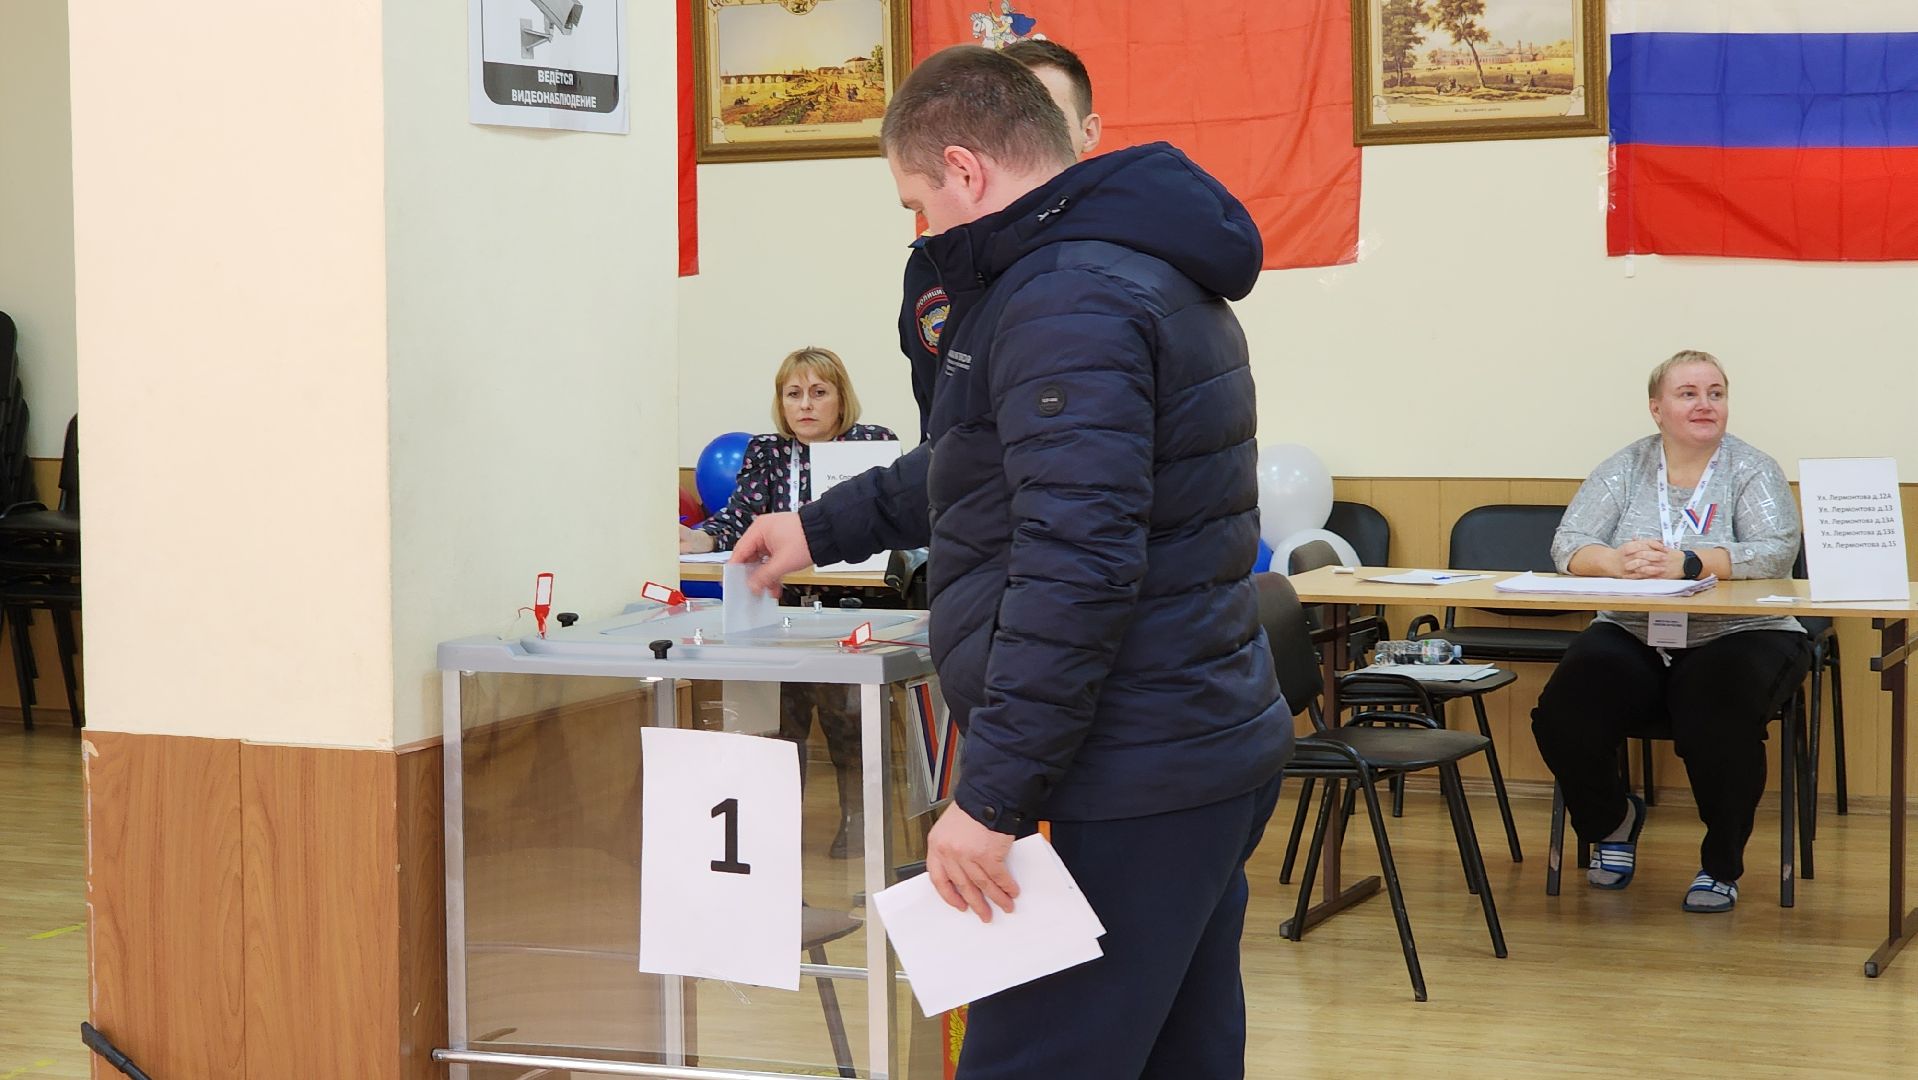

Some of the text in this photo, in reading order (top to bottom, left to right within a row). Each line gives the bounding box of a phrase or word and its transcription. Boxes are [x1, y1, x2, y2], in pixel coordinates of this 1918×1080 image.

[537, 69, 574, 86] ВЕДЁТСЯ
[511, 88, 597, 109] ВИДЕОНАБЛЮДЕНИЕ
[1829, 493, 1871, 501] Лермонтова
[1833, 529, 1875, 537] Лермонтова
[1835, 541, 1879, 549] Лермонтова
[710, 798, 751, 875] 1
